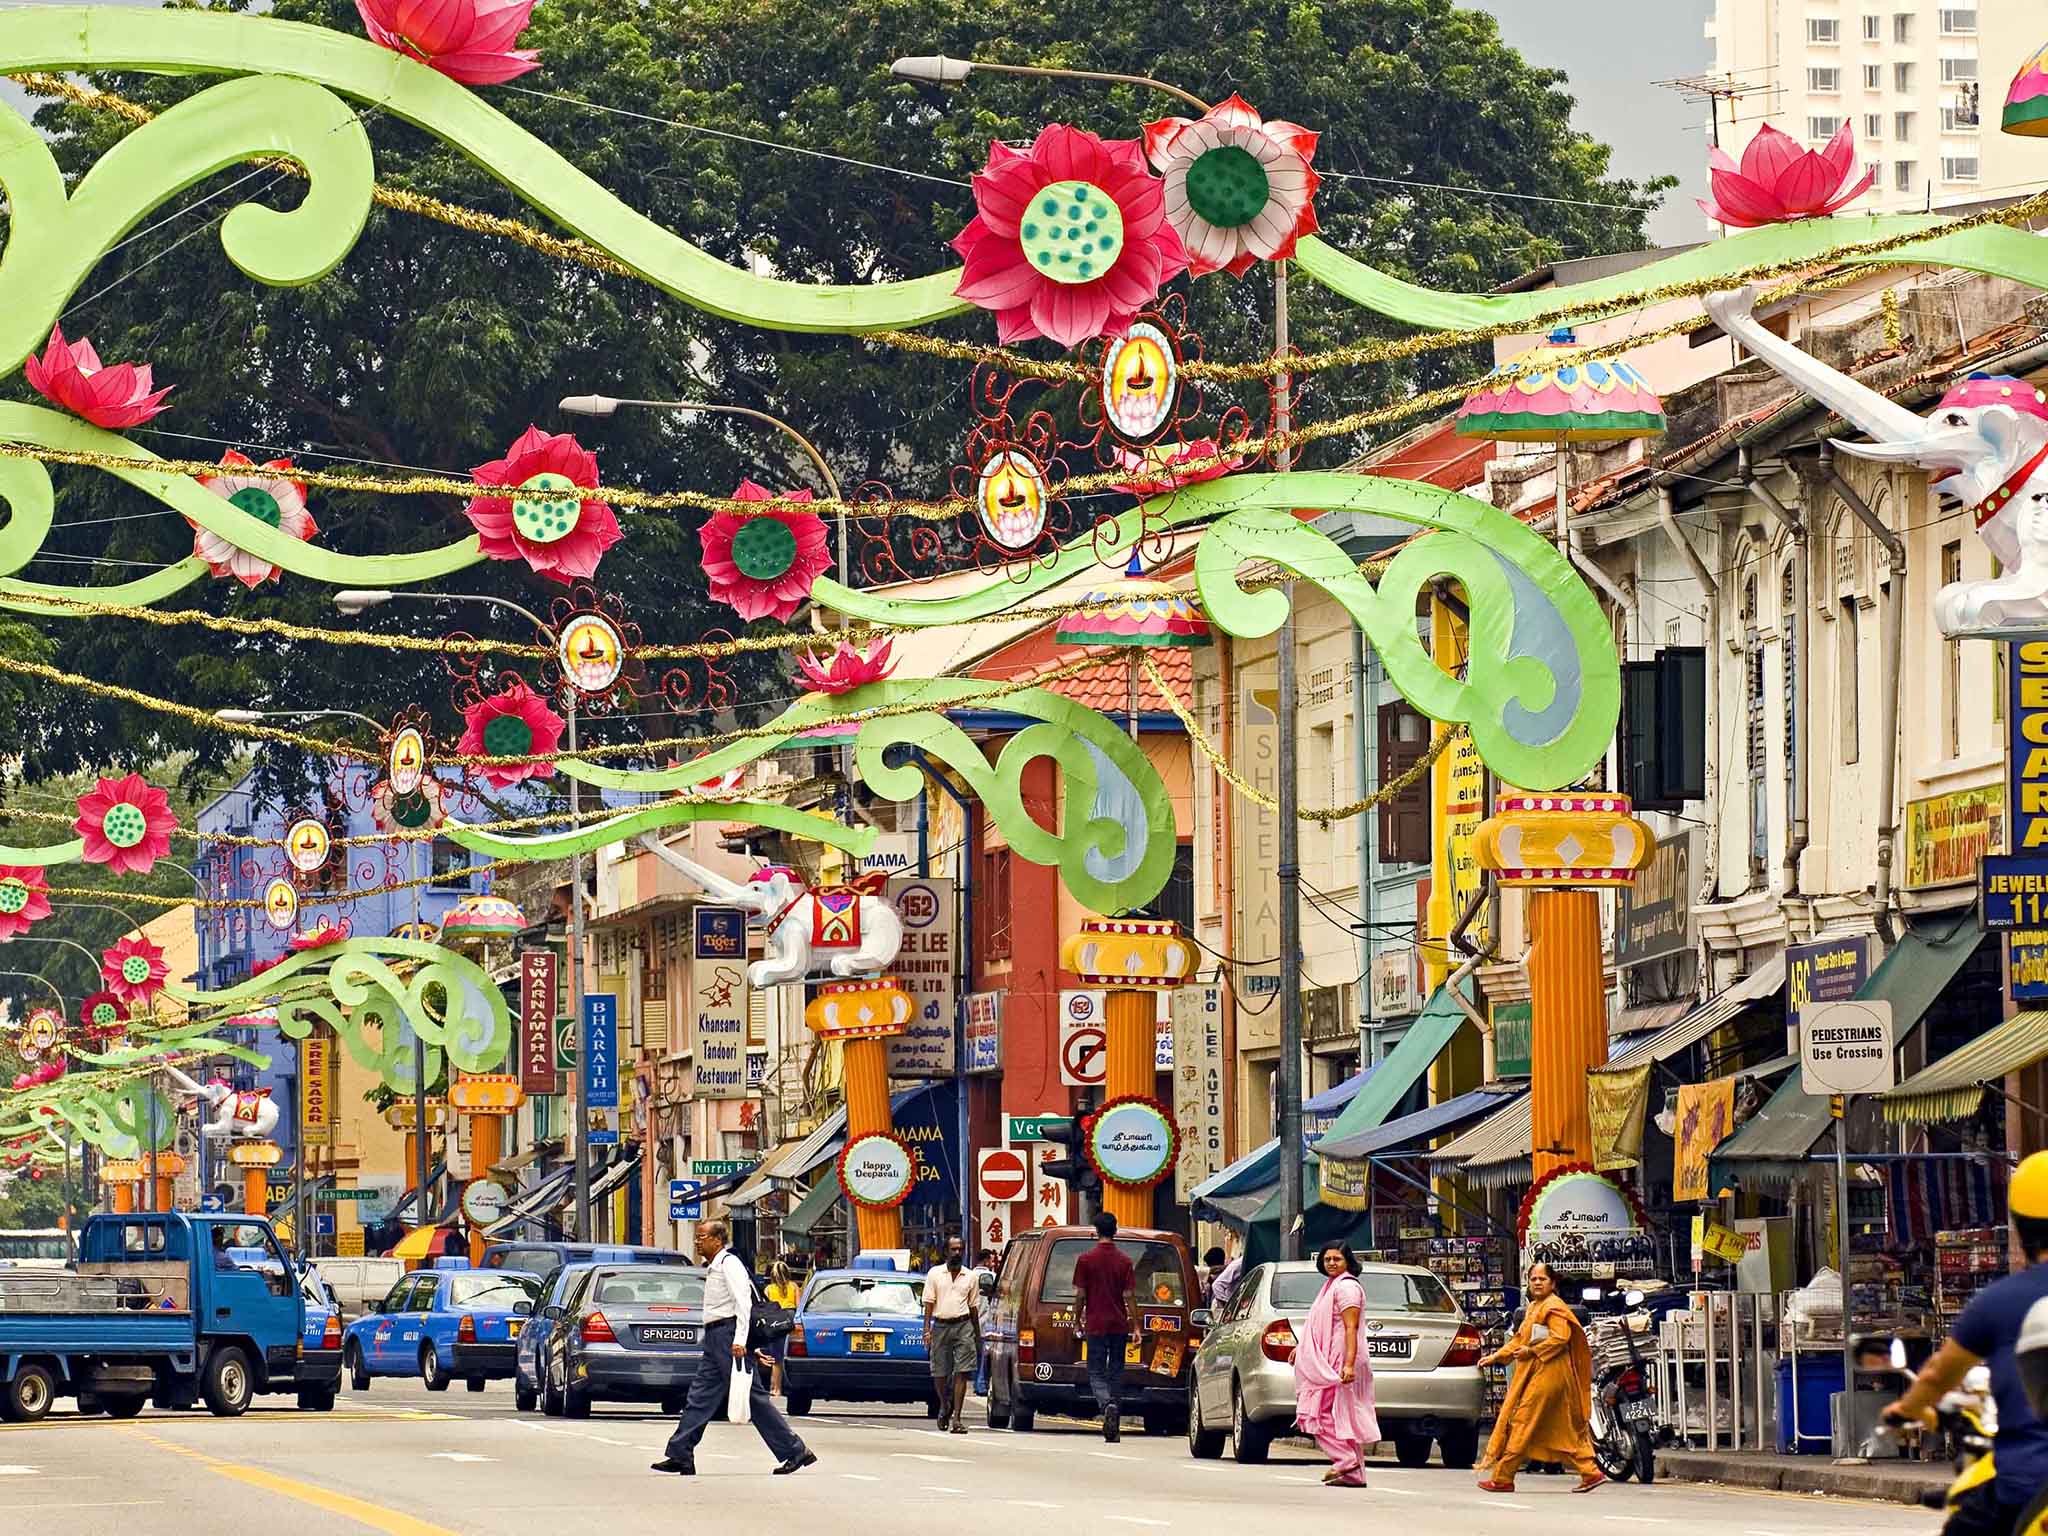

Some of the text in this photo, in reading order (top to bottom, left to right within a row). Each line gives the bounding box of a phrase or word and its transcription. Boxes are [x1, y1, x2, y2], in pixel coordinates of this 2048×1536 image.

[1255, 735, 1277, 958] SHEETAL
[864, 854, 907, 867] MAMA
[1989, 875, 2048, 893] JEWEL
[902, 895, 933, 917] 152
[703, 934, 736, 951] Tiger
[901, 933, 948, 953] EE LEE
[922, 979, 946, 993] LTD.
[1791, 959, 1811, 1013] ABC
[1205, 989, 1217, 1012] HO
[529, 957, 548, 1074] SWARNAMAHAL
[699, 1013, 741, 1033] Khansama
[1206, 1023, 1218, 1057] LEE
[1812, 1027, 1882, 1041] PEDESTRIANS
[592, 1002, 607, 1088] BHARATH
[703, 1040, 737, 1060] Tandoori
[1813, 1046, 1883, 1060] Use Crossing
[309, 1043, 321, 1076] SREE
[697, 1066, 742, 1084] Restaurant
[1208, 1068, 1219, 1115] AUTO
[308, 1080, 322, 1123] SAGAR
[894, 1125, 944, 1141] MAMA
[1208, 1126, 1219, 1149] CO
[913, 1146, 926, 1161] &
[695, 1162, 732, 1174] Norris
[855, 1169, 900, 1179] Deepavali
[863, 1161, 892, 1171] Happy
[916, 1165, 941, 1182] PA
[672, 1207, 699, 1216] ONE WAY
